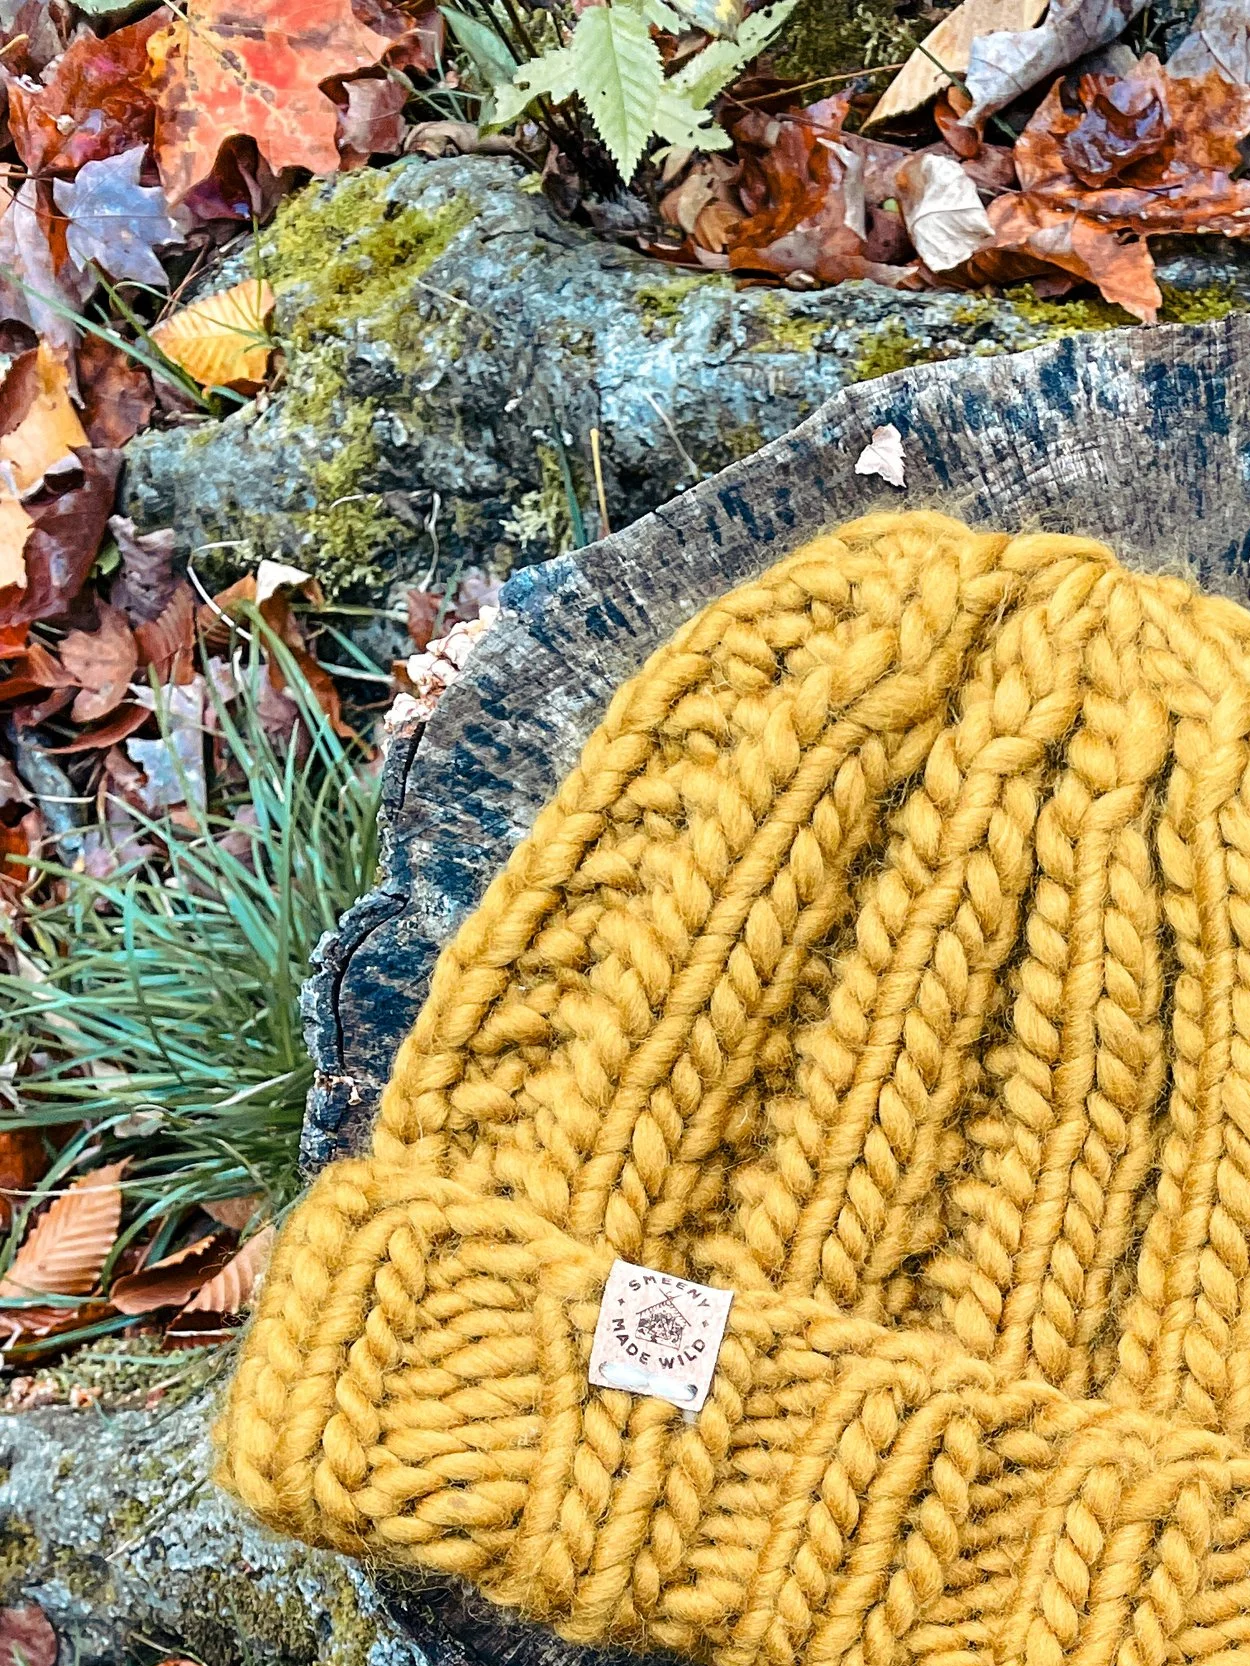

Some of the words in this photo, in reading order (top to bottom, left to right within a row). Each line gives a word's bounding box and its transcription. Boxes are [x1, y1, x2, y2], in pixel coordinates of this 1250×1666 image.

[628, 1275, 711, 1308] SMEENY
[611, 1318, 651, 1365] MADE
[658, 1338, 706, 1370] WILD
